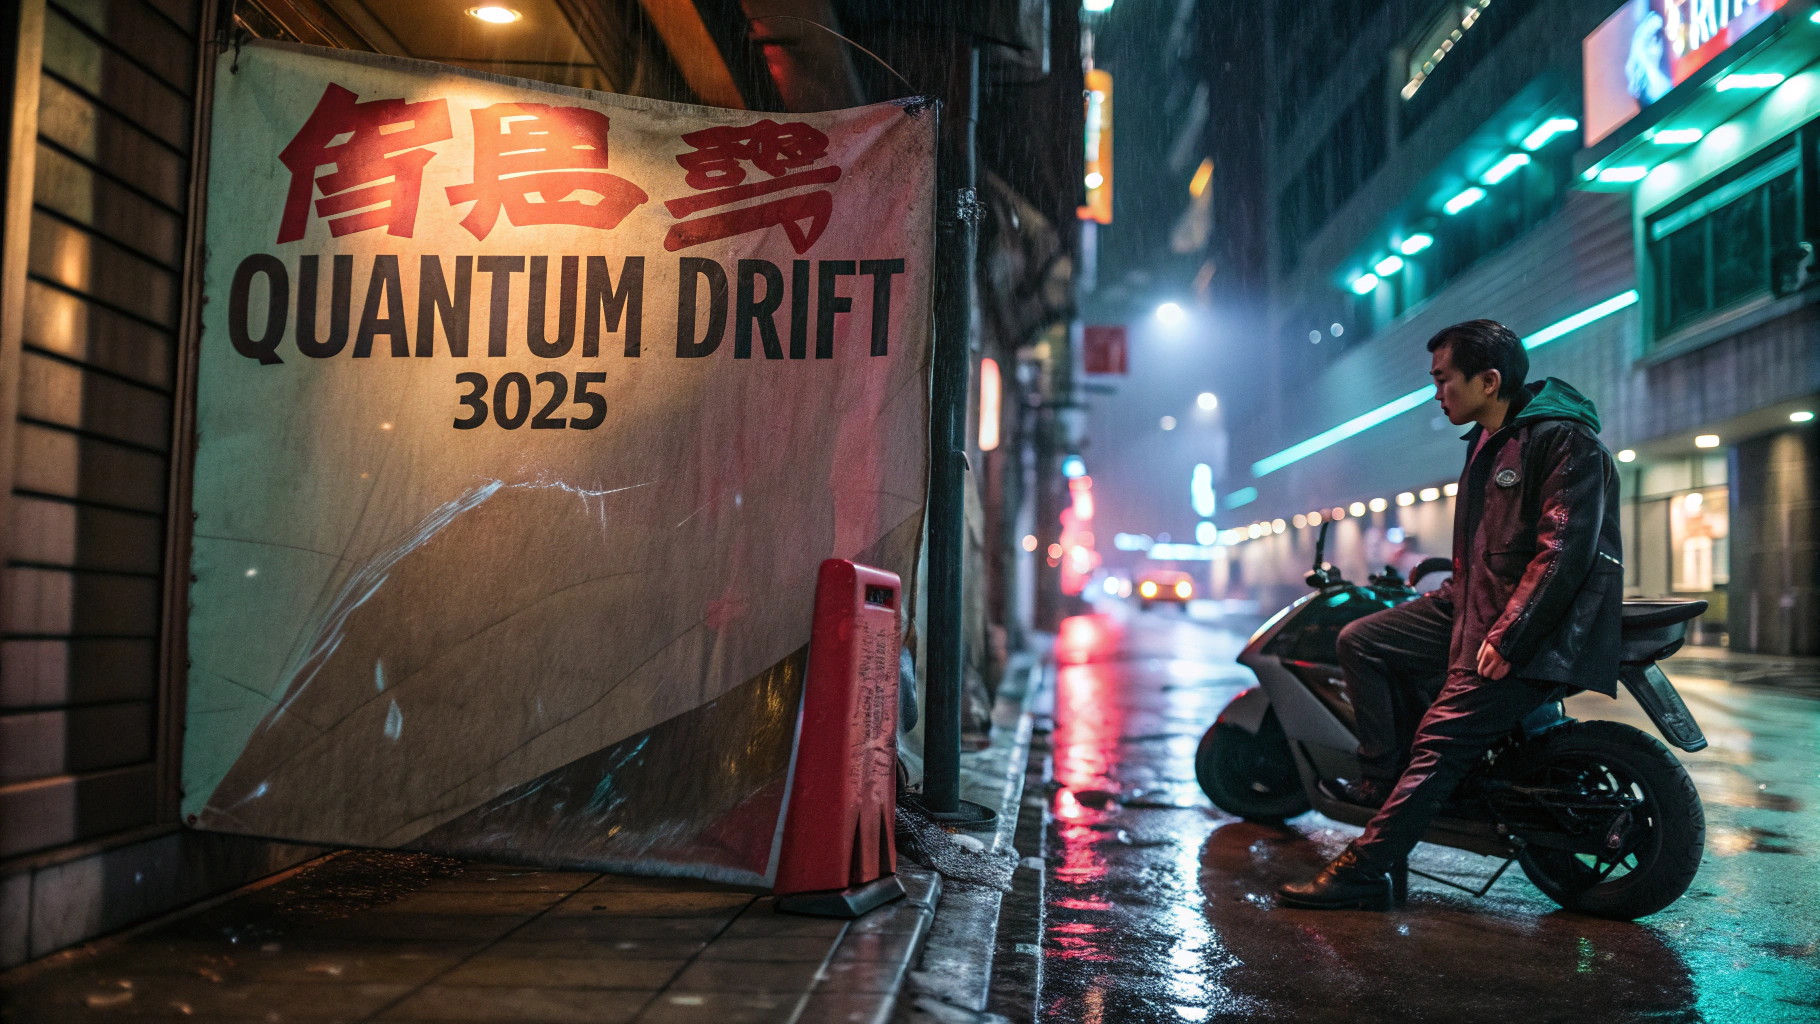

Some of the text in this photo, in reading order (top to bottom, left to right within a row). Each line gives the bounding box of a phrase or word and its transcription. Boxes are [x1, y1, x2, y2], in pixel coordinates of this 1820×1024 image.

[228, 253, 905, 366] QUANTUM DRIFT
[452, 371, 608, 431] 3025
